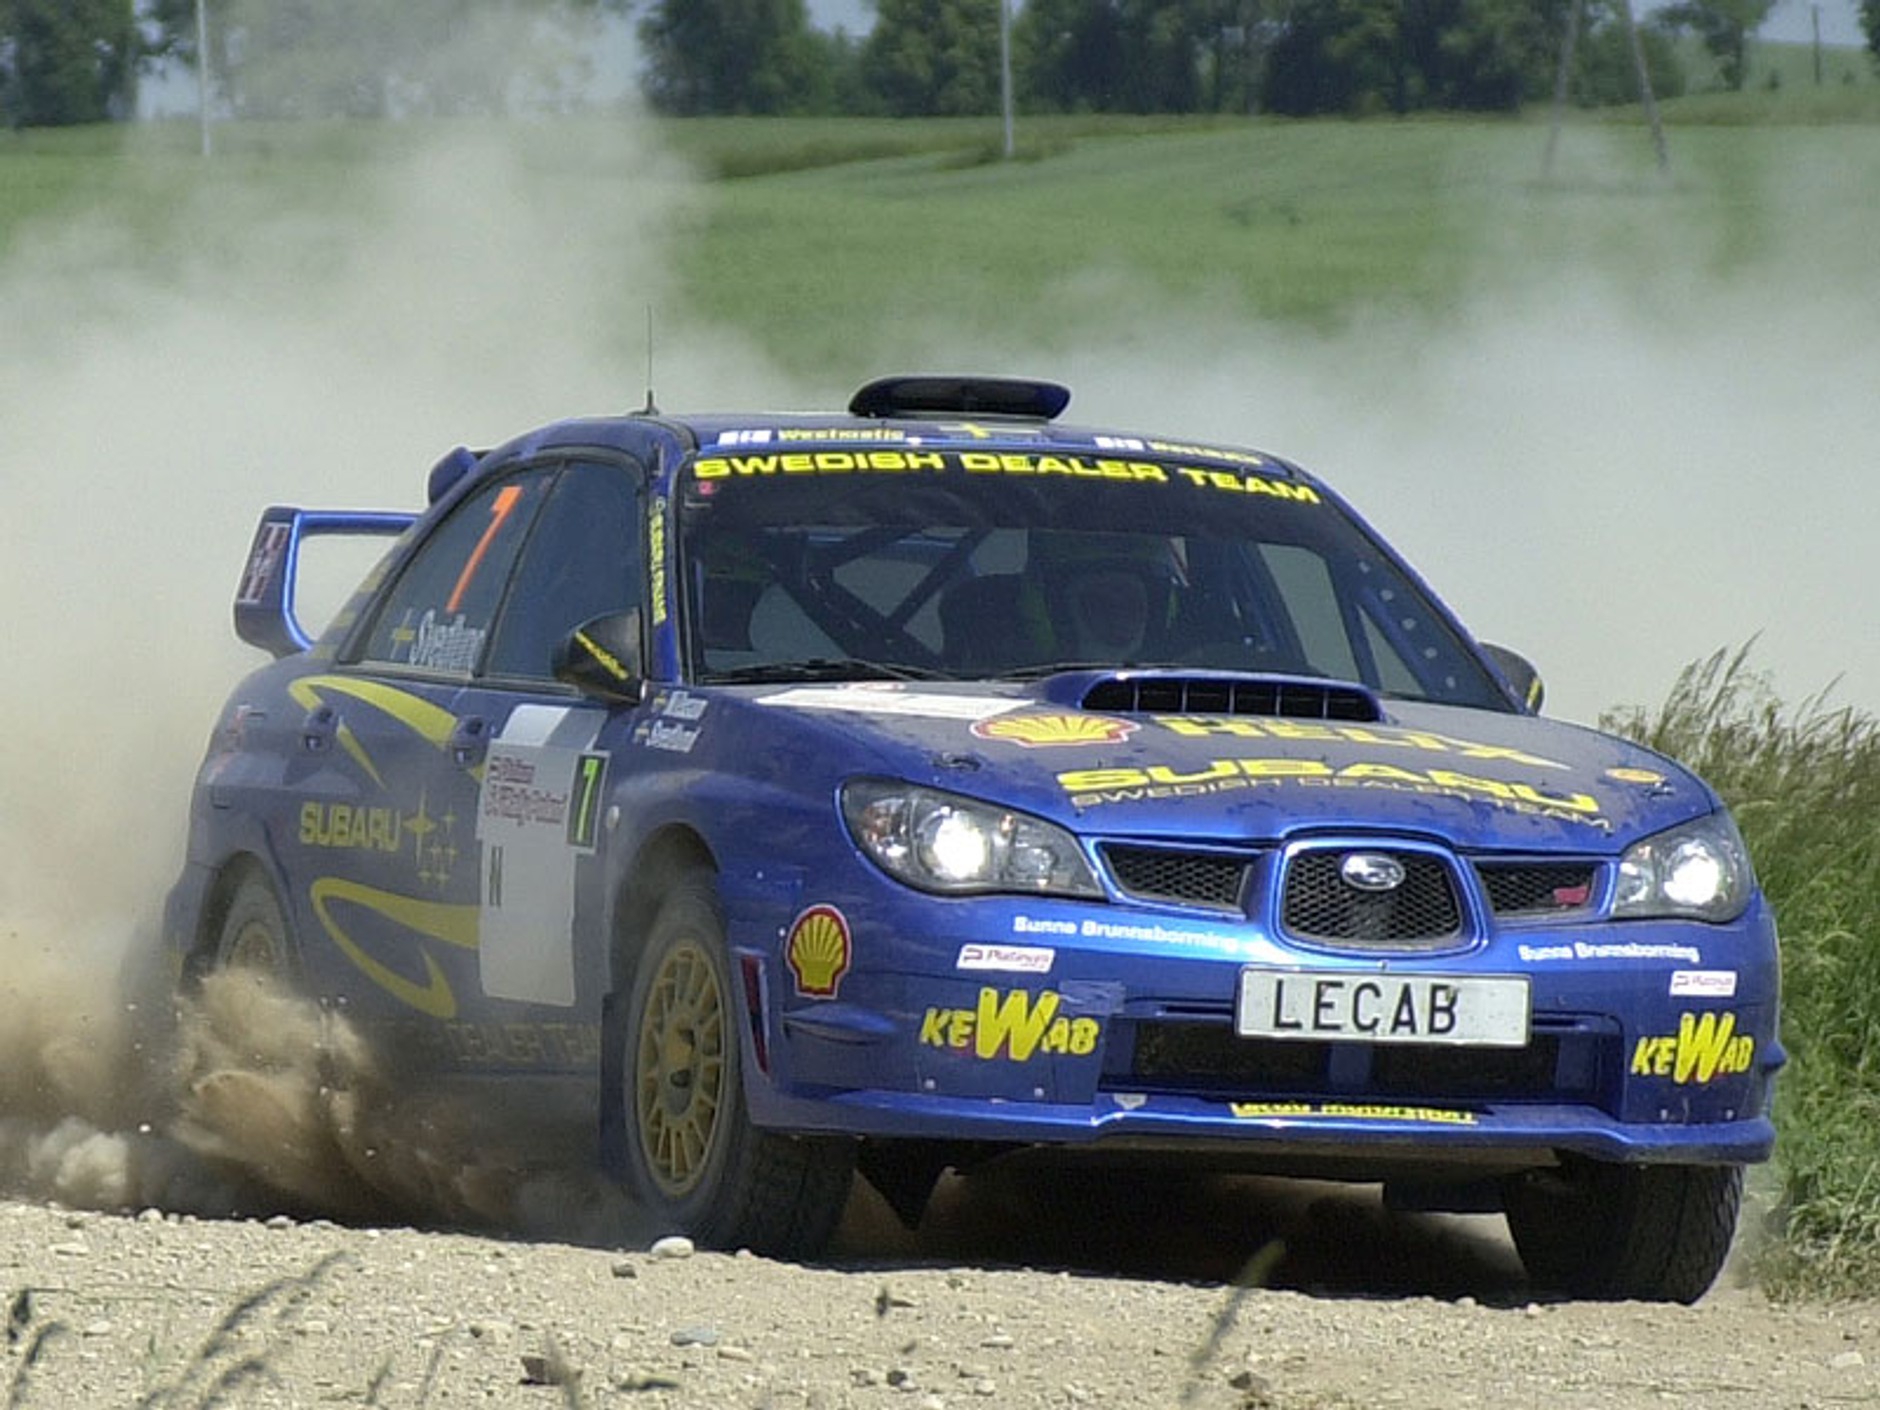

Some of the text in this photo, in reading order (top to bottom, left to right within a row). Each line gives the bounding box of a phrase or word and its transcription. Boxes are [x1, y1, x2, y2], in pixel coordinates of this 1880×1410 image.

[694, 452, 945, 479] SWEDISH
[959, 452, 1168, 482] DEALER
[1178, 467, 1321, 504] TEAM
[1151, 714, 1571, 772] HELIX
[1056, 757, 1600, 813] SUBARU
[1071, 777, 1281, 814] SWEDISH
[299, 801, 400, 852] SUBARU
[919, 986, 1100, 1061] KEWAB
[1272, 978, 1459, 1038] LECAB
[1630, 1011, 1755, 1084] KEWAB
